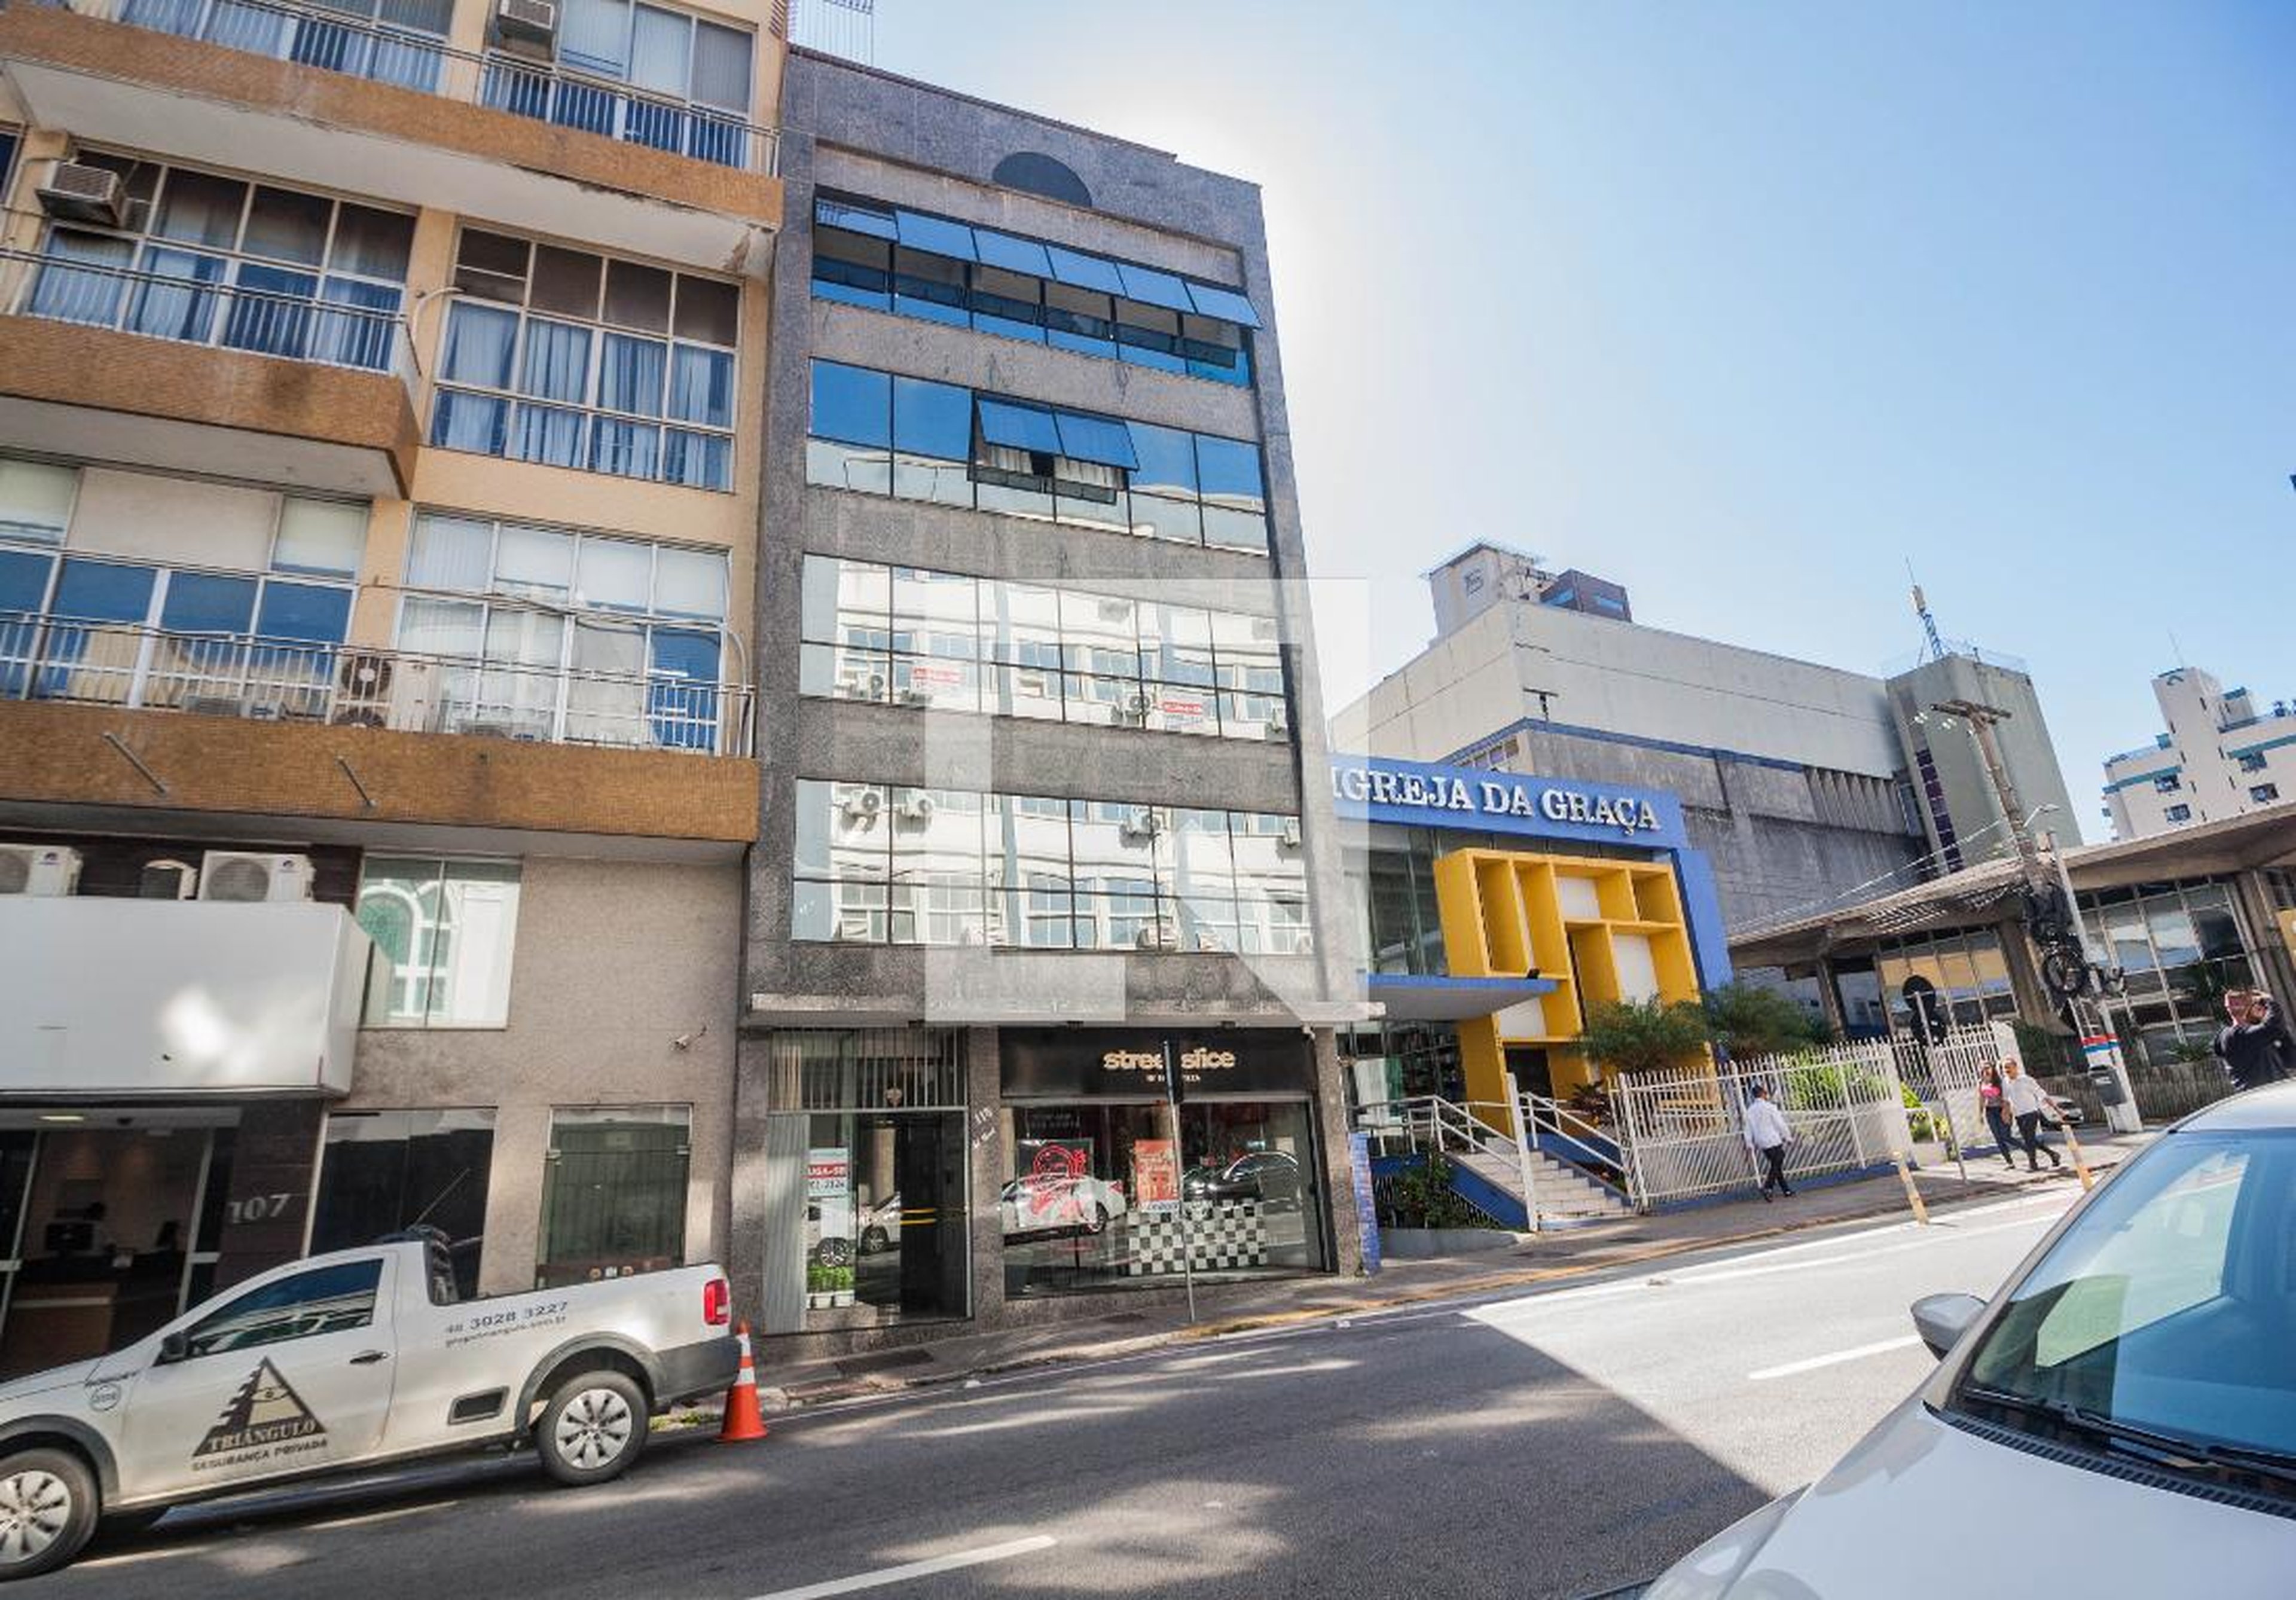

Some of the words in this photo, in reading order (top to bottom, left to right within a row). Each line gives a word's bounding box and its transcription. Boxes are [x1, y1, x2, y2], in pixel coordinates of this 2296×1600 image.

[1331, 766, 1475, 811] IGREJA
[1480, 781, 1534, 817] DA
[1541, 788, 1662, 835] GRAÇA
[227, 1193, 291, 1225] 107
[469, 1311, 517, 1330] 3028
[274, 1438, 328, 1457] PRIVADA
